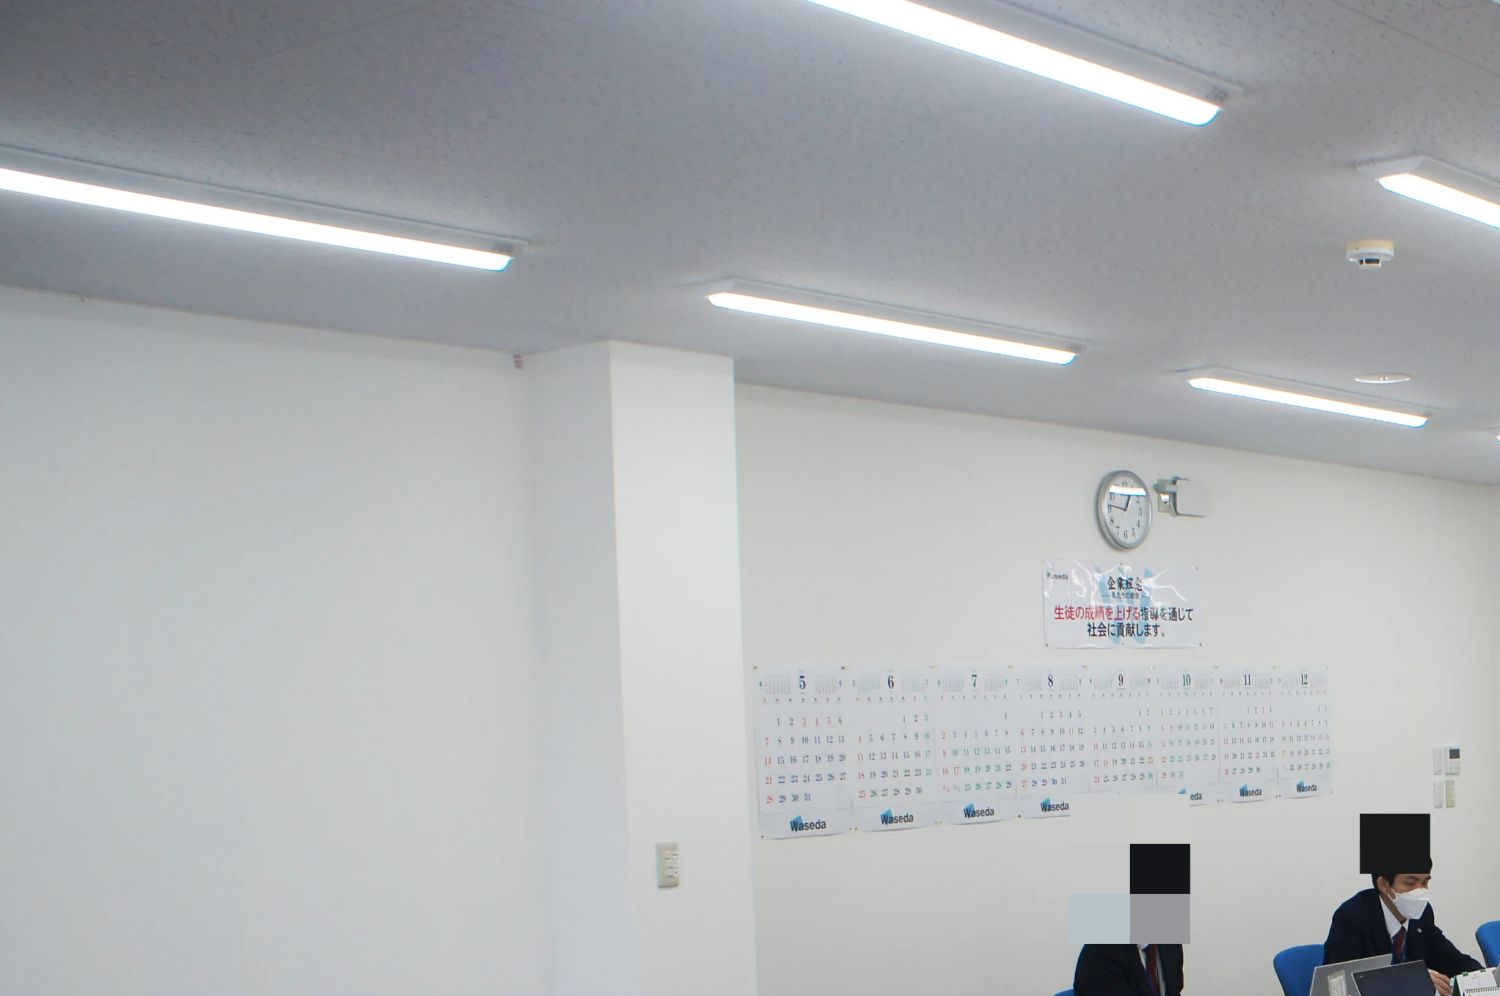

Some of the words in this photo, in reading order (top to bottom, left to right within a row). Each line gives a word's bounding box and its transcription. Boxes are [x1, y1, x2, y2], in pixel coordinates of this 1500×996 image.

[1054, 605, 1194, 622] 生徒の成績を上げる指導を通じて
[1087, 622, 1166, 638] 社会に貢献します。
[799, 675, 806, 690] 5
[887, 674, 895, 689] 6
[971, 674, 978, 688] 7
[1047, 674, 1054, 687] 8
[1118, 673, 1124, 686] 9
[1182, 673, 1191, 686] 10
[1243, 674, 1251, 685] 11
[1300, 673, 1308, 685] 12
[1239, 787, 1262, 797] Waseda
[1296, 783, 1318, 792] Waseda
[963, 806, 995, 819] Waseda
[1040, 801, 1070, 813] Waseda
[790, 819, 827, 832] Waseda
[880, 813, 914, 825] Waseda
